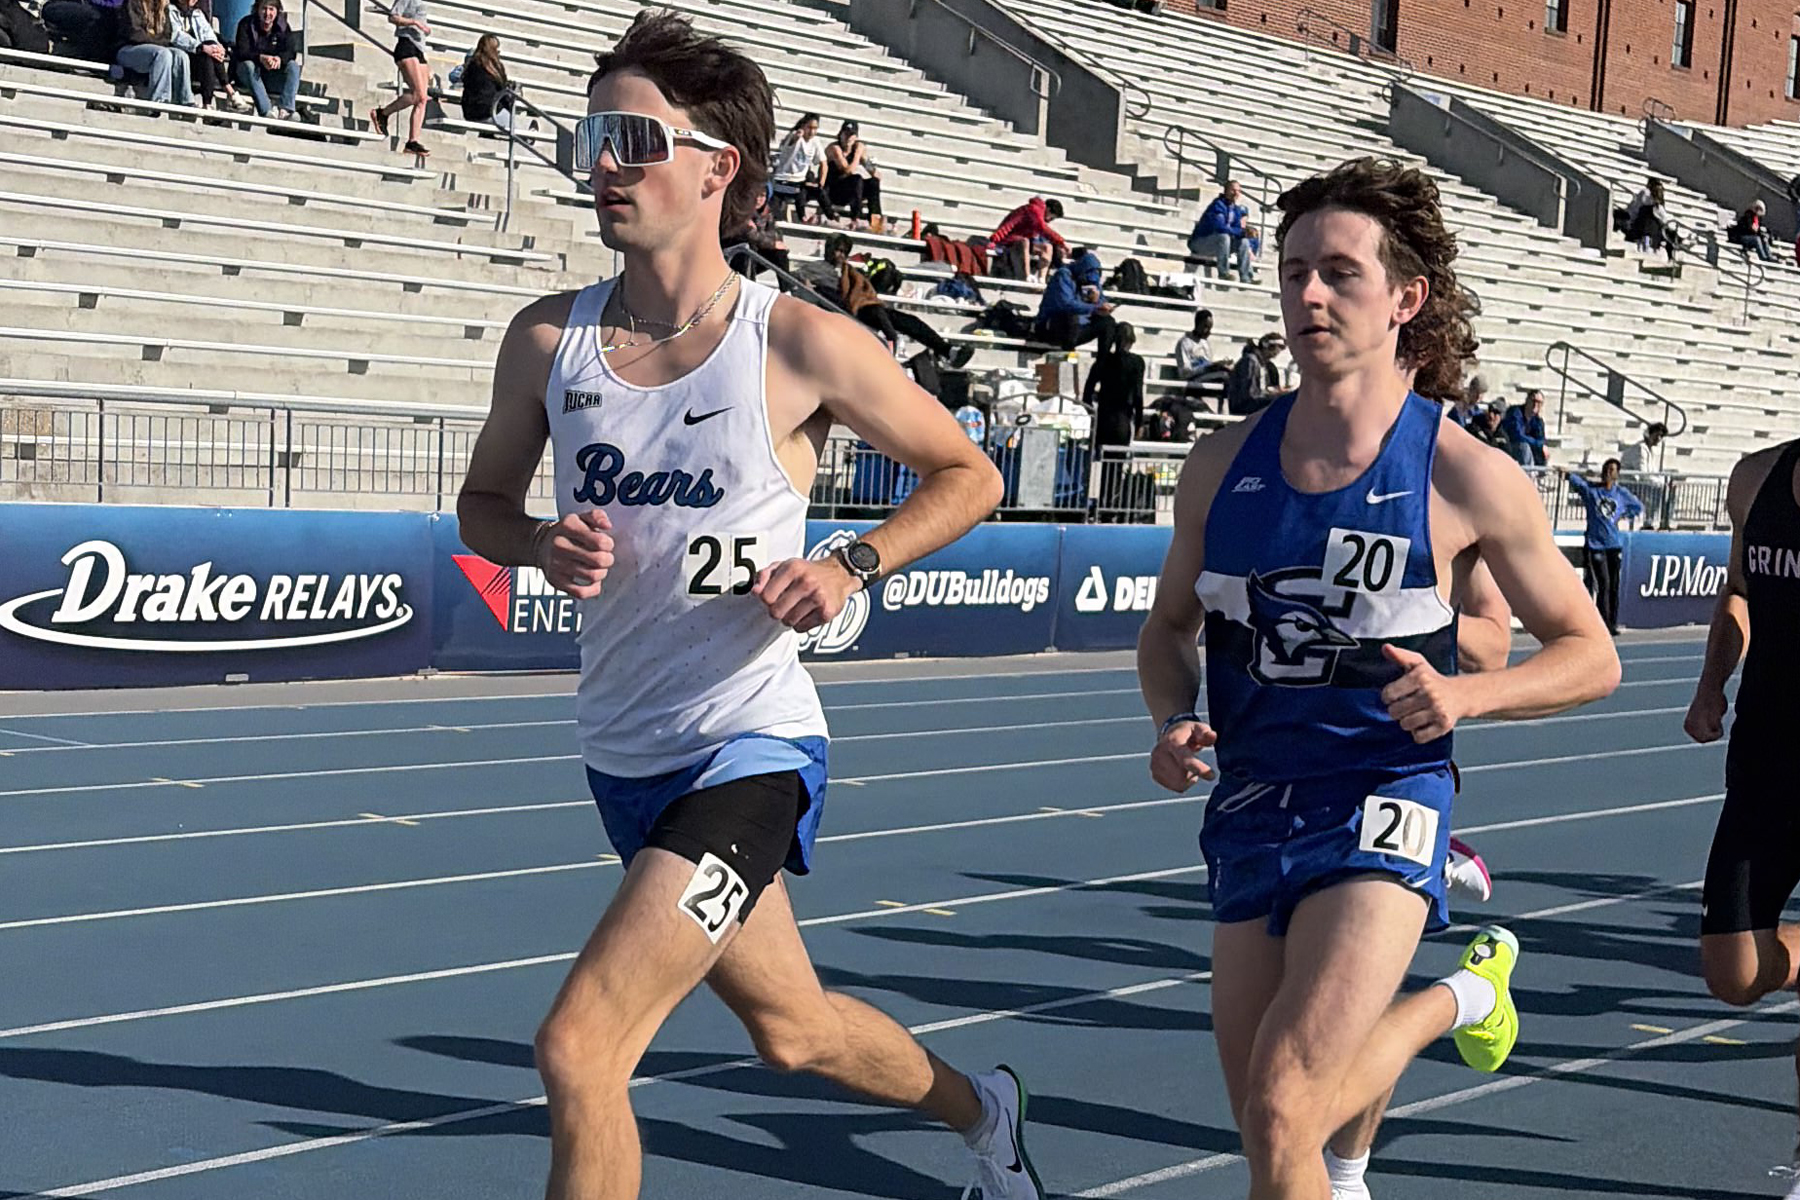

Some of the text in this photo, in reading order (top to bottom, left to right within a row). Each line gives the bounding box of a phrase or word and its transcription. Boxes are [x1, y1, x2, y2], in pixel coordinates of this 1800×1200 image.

[573, 443, 724, 508] Bears
[51, 540, 257, 622] Drake
[688, 535, 757, 596] 25
[882, 569, 1049, 611] @DUBulldogs
[1333, 534, 1395, 592] 20
[1372, 802, 1427, 857] 20
[683, 863, 744, 933] 25
